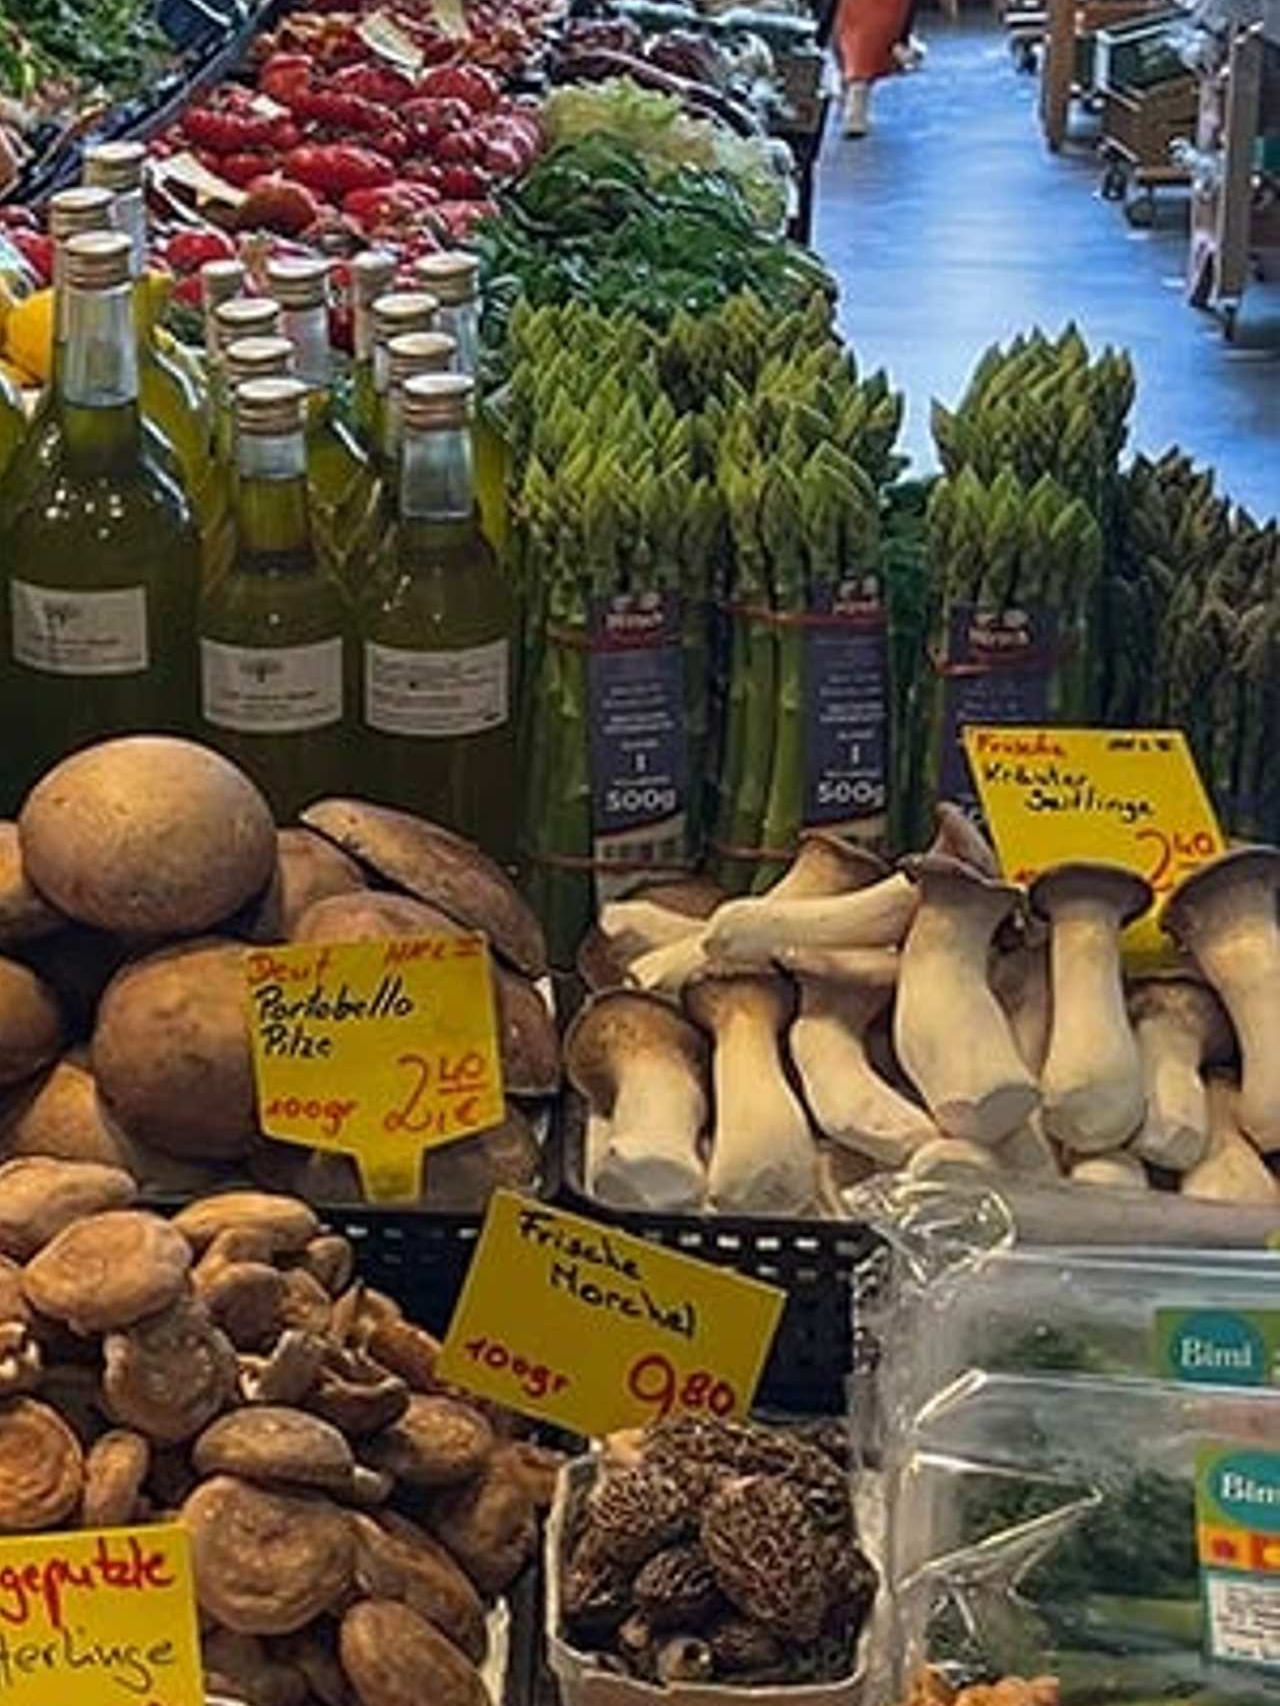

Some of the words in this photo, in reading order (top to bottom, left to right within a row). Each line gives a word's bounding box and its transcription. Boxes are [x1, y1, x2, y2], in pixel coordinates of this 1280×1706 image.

[260, 1024, 332, 1059] Pilze
[516, 1207, 642, 1283] Frische
[1179, 1336, 1254, 1370] Bimi
[1220, 1471, 1280, 1504] Bim
